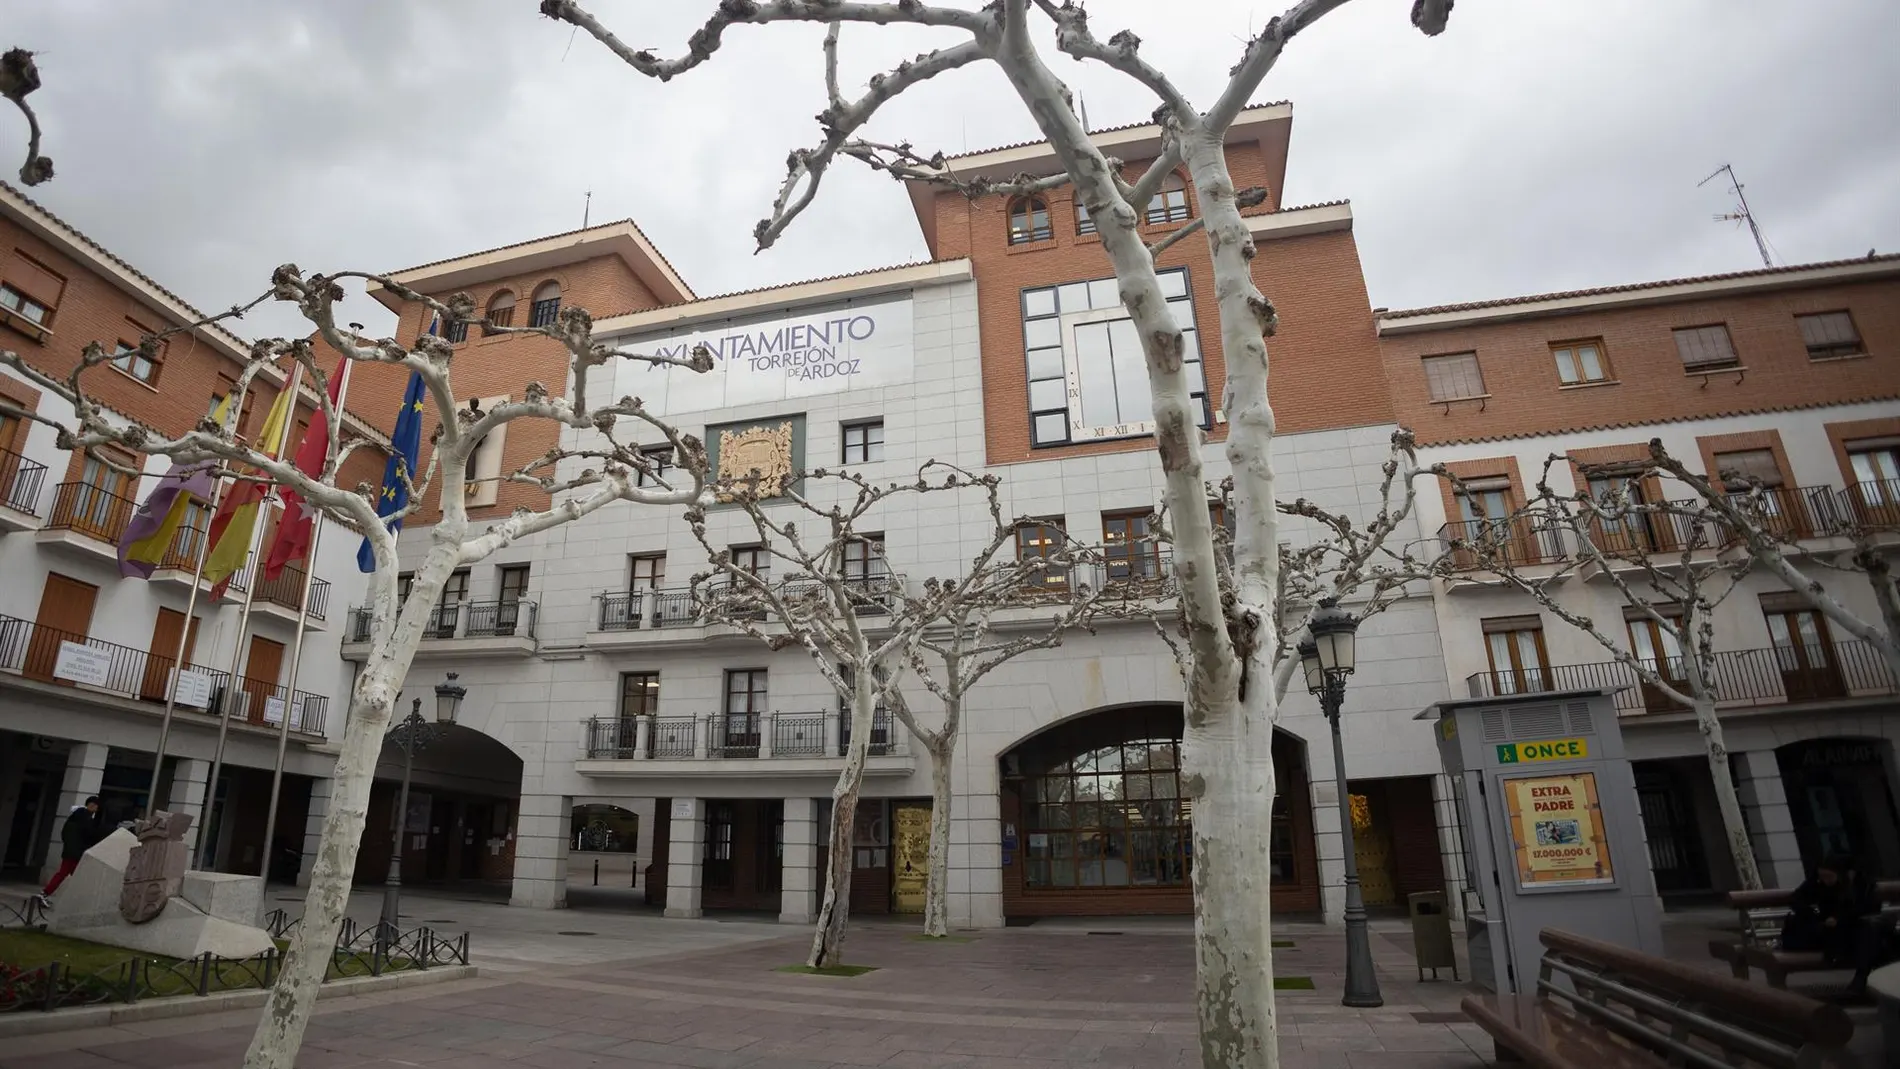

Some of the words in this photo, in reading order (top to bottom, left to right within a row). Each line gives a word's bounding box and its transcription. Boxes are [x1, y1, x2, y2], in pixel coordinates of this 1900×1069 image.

[748, 345, 836, 373] TORREJÓN
[788, 366, 800, 378] DE
[800, 359, 861, 382] ARDOZ
[1069, 389, 1079, 398] IX
[1073, 421, 1080, 430] X
[1094, 428, 1104, 437] XI
[1114, 425, 1128, 435] XII
[1524, 742, 1580, 758] ONCE
[1531, 785, 1571, 797] EXTRA
[1534, 800, 1574, 812] PADRE
